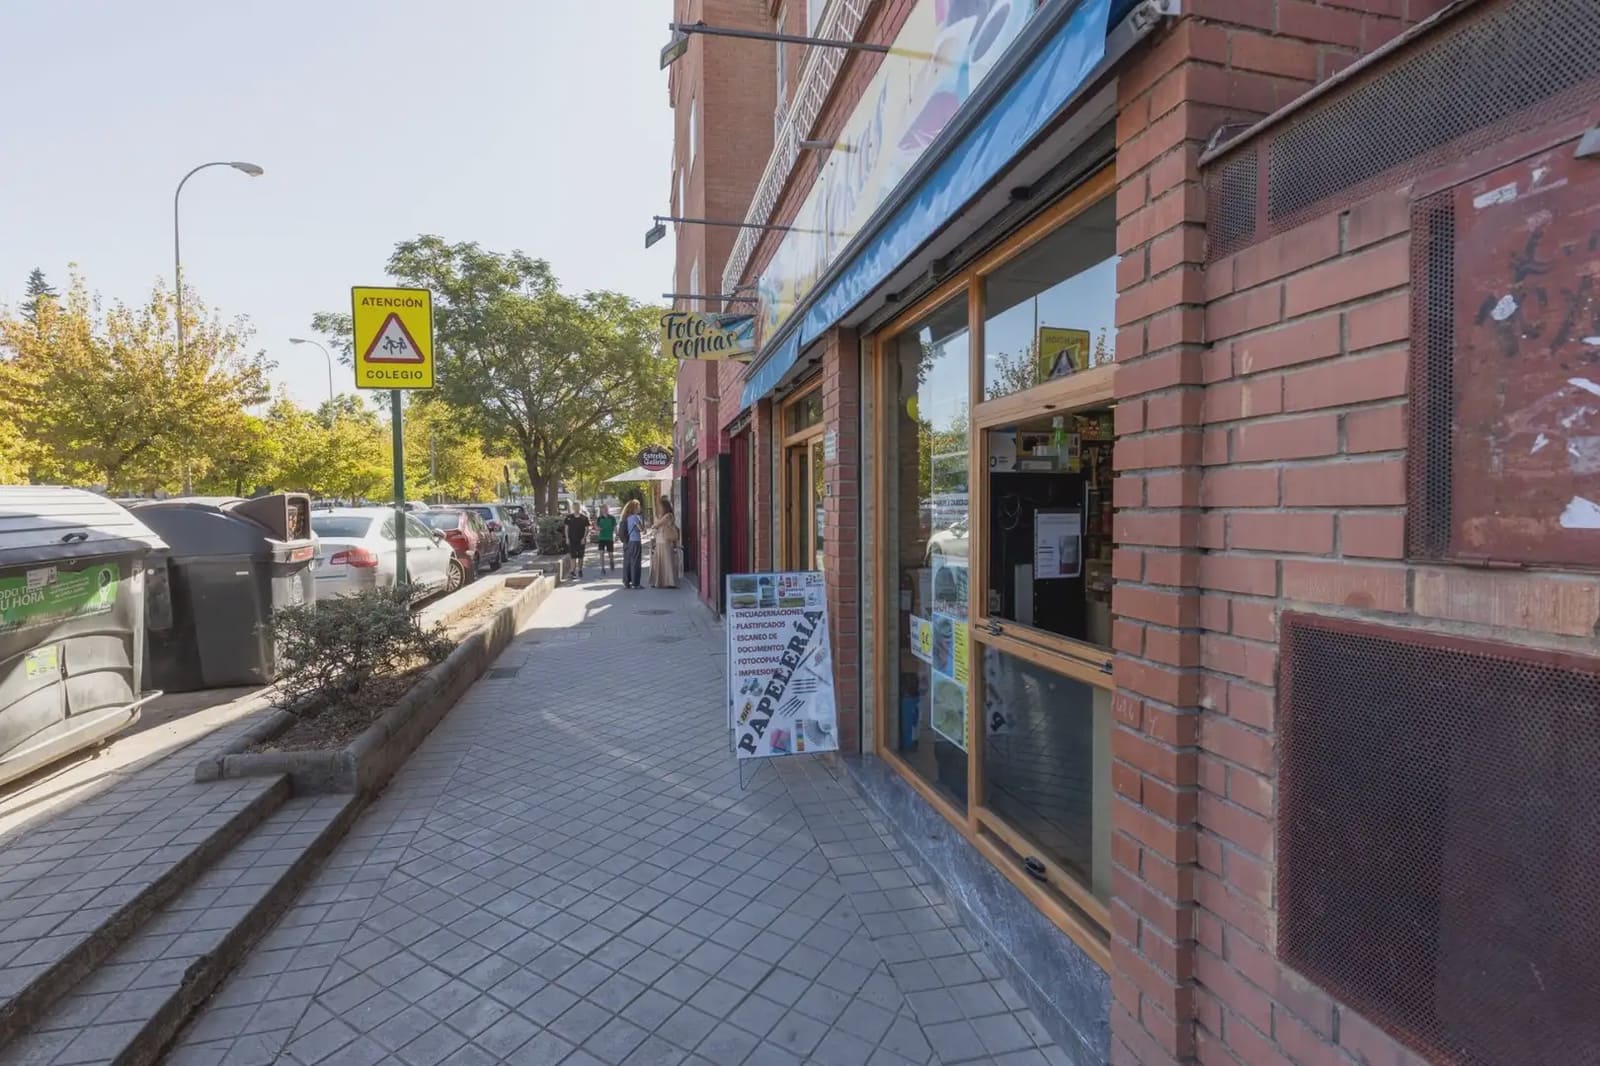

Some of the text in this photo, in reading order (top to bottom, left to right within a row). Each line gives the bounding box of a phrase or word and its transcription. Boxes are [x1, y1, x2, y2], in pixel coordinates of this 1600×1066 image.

[361, 297, 423, 308] ATENCIÓN
[660, 312, 706, 340] Foto
[672, 330, 737, 360] copias
[366, 369, 423, 380] COLEGIO
[12, 591, 45, 609] HORA
[735, 608, 805, 618] ENCUADERNACIONES
[736, 621, 786, 630] PLASTIFICADOS
[736, 632, 778, 642] ESCANEO DE
[737, 644, 785, 653] DOCUMENTOS
[737, 656, 780, 665] FOTOCOPIAS
[738, 611, 824, 754] PAPELERÍA
